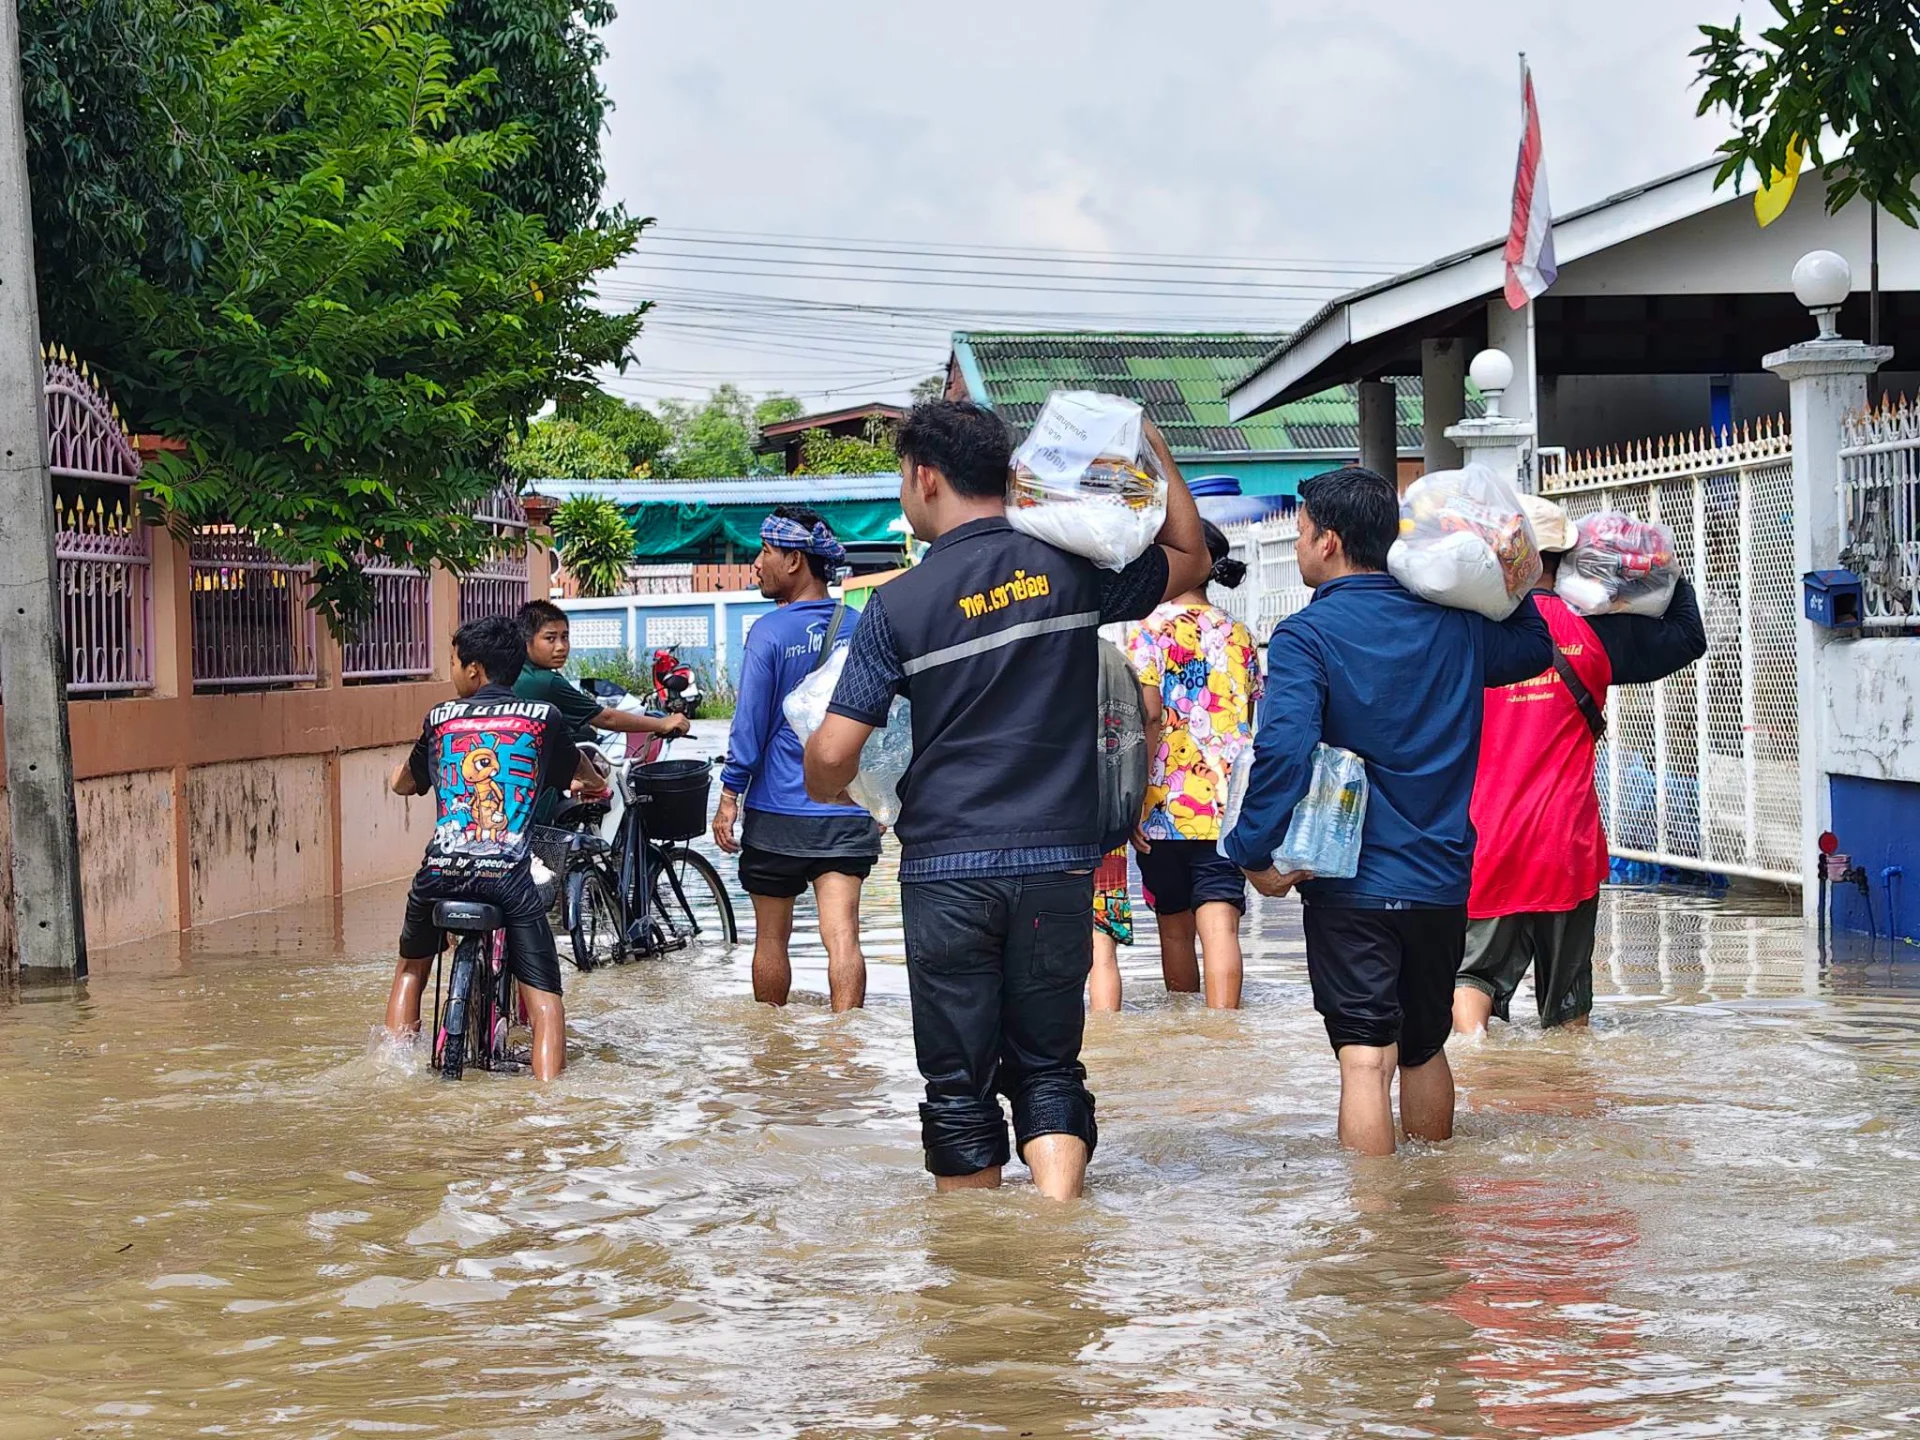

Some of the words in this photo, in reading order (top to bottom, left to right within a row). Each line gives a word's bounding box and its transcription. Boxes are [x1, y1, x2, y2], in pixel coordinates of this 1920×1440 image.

[958, 569, 1050, 619] ทต.เขาย้อย
[1557, 643, 1584, 656] uild
[456, 856, 470, 868] by
